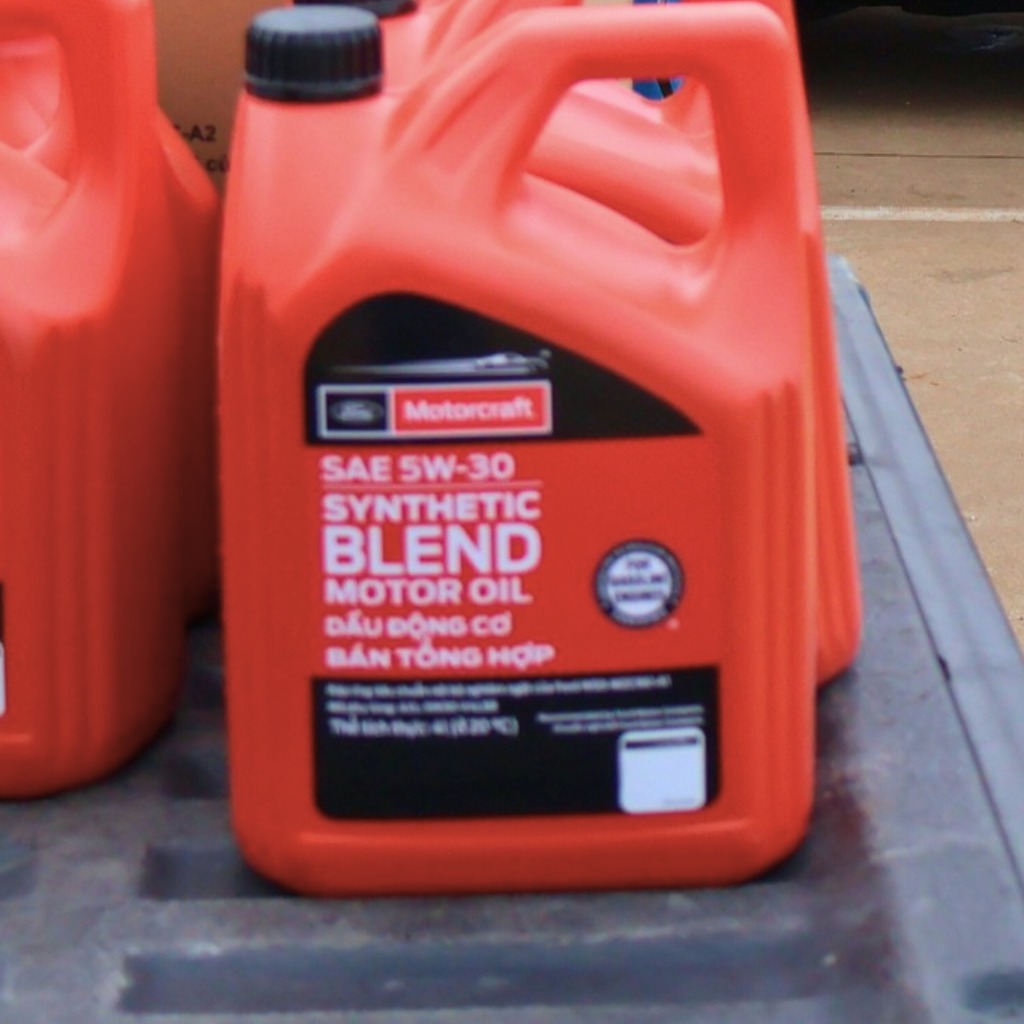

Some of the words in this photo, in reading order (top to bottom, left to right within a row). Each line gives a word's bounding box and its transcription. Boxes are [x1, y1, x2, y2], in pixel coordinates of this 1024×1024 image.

[404, 396, 535, 422] Motorcraft
[320, 455, 393, 482] SAE
[400, 452, 516, 482] 5W-30
[322, 490, 542, 522] SYNTHETIC
[323, 522, 542, 576] BLEND
[324, 578, 463, 606] MOTOR
[469, 577, 534, 605] OIL
